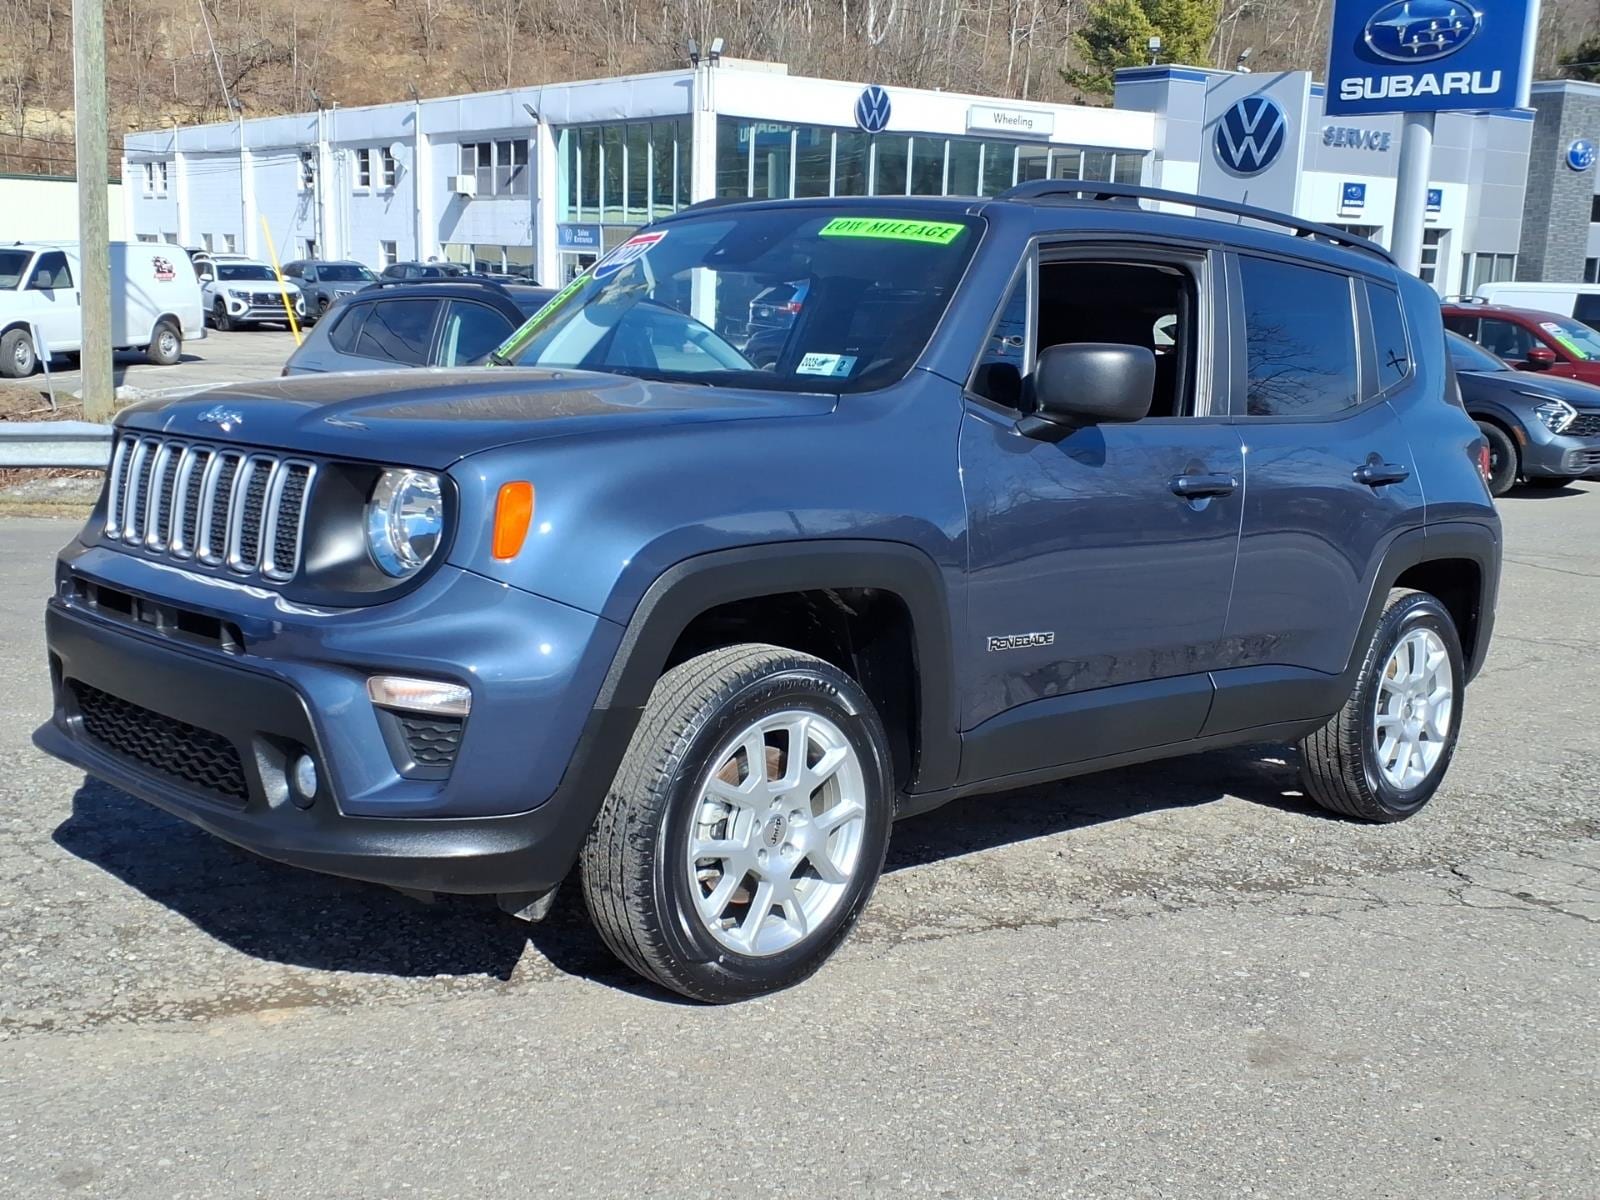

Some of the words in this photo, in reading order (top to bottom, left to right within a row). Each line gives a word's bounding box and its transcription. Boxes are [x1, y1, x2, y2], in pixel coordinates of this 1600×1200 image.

[1340, 70, 1502, 101] SUBARU
[993, 112, 1033, 128] Wheeling
[1219, 97, 1285, 168] VW
[1322, 126, 1392, 152] SERVICE
[827, 220, 868, 233] LOW
[866, 222, 957, 239] MILEAGE
[986, 631, 1055, 651] RENEGADE
